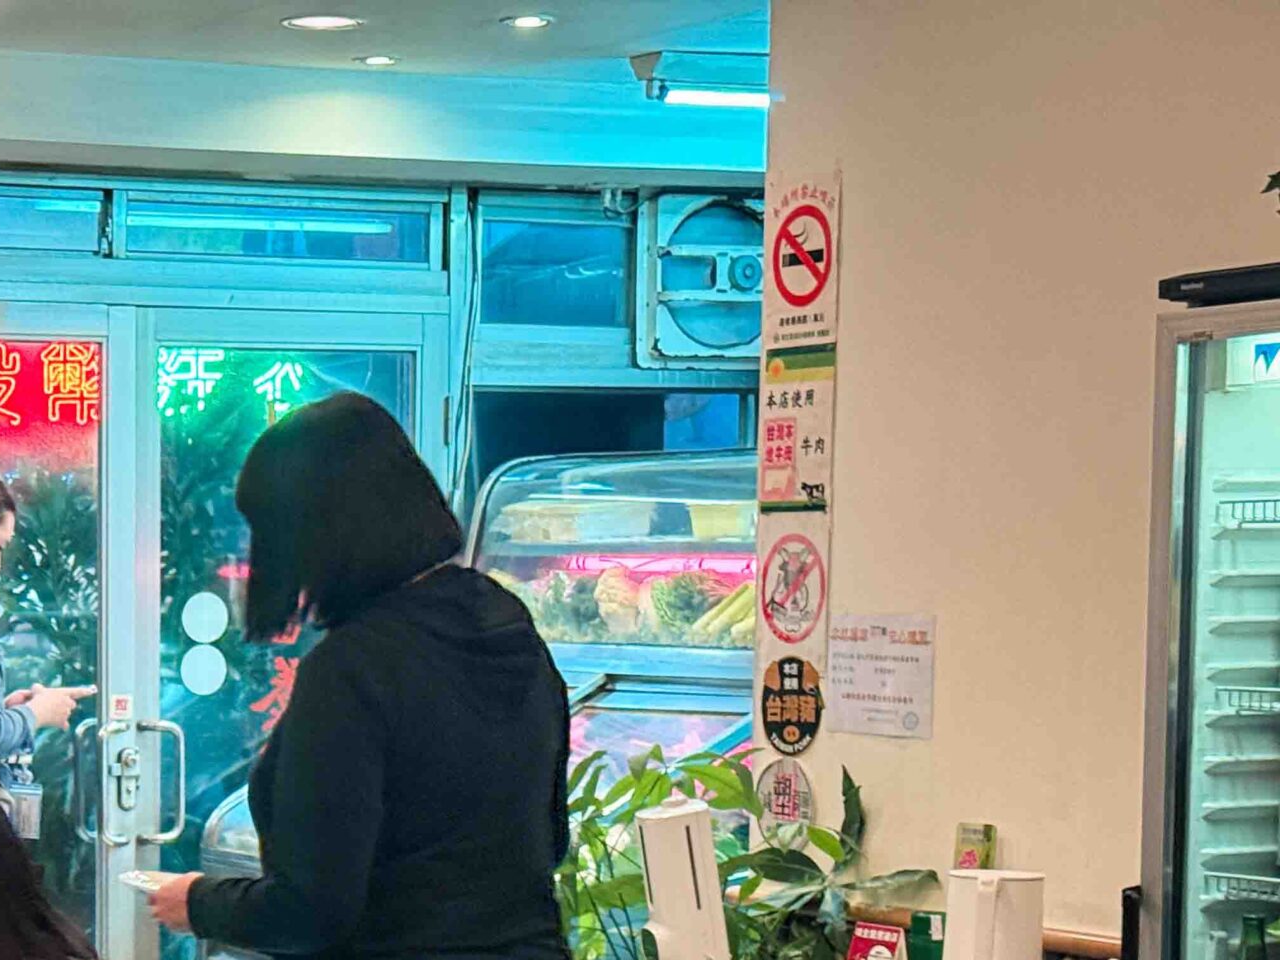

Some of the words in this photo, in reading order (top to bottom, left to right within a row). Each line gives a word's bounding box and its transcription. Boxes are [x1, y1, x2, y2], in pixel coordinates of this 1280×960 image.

[766, 388, 815, 411] 本店使用
[800, 435, 825, 457] 牛肉
